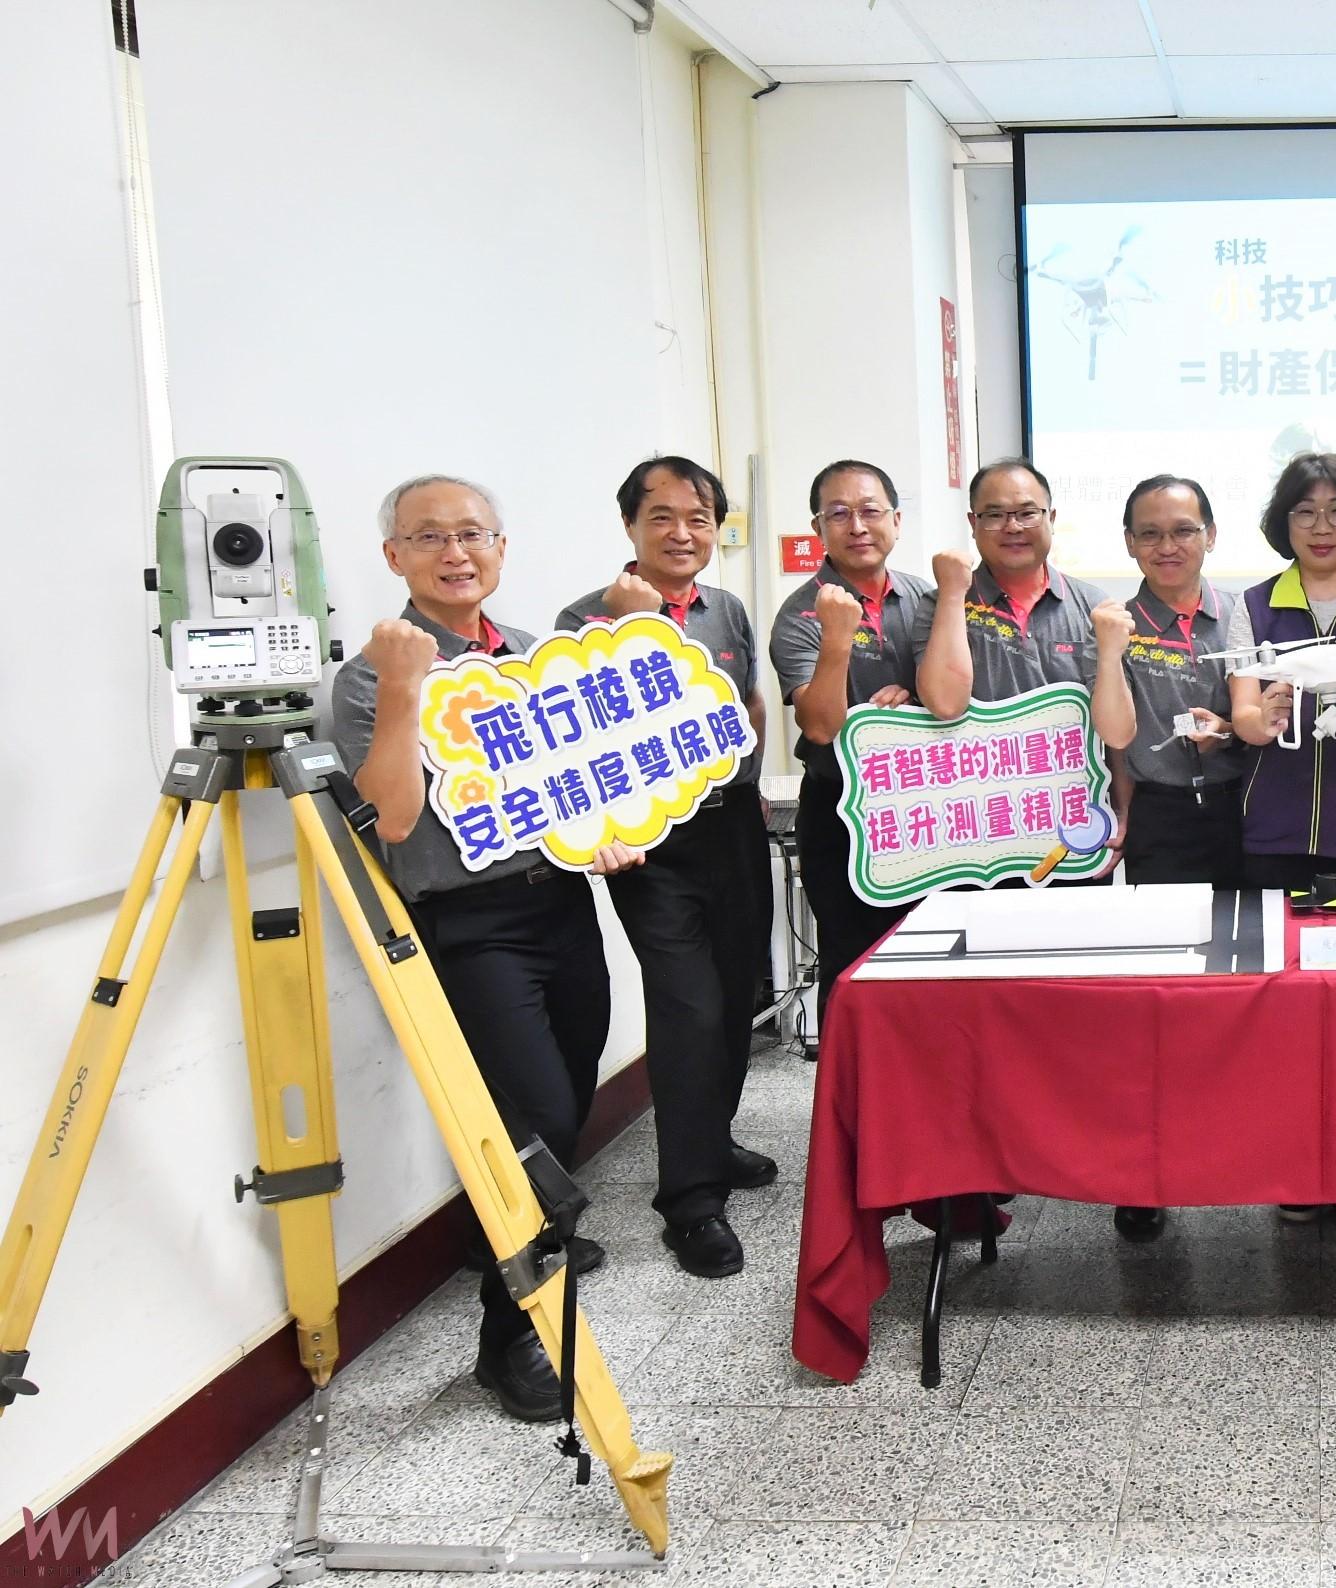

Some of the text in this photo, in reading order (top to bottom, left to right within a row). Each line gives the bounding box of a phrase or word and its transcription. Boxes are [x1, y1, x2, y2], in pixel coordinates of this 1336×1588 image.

[1215, 238, 1267, 266] 科技
[799, 559, 815, 567] Fire
[1055, 644, 1074, 653] FILA
[470, 650, 683, 772] 飛行稜鏡
[452, 702, 750, 862] 安全精度雙保障
[861, 727, 1086, 793] 有智慧的測量標
[868, 786, 1091, 854] 提升測量精度
[48, 1065, 89, 1159] SOKKIA
